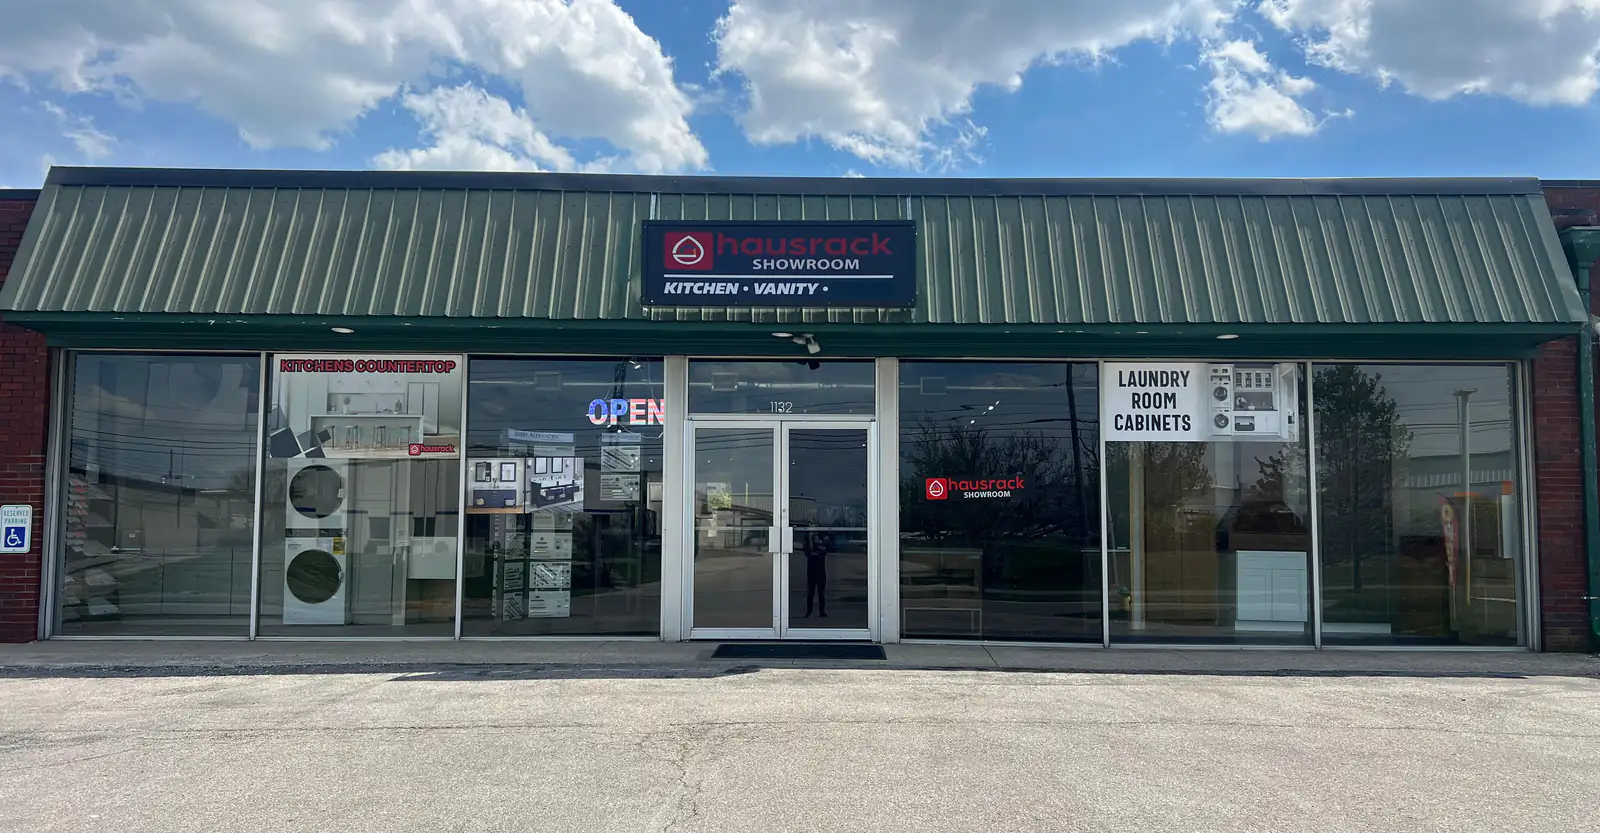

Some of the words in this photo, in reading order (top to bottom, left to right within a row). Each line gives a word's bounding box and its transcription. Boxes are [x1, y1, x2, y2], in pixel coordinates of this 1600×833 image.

[717, 232, 892, 255] hausrack
[752, 258, 860, 271] SHOWROOM
[664, 282, 739, 295] KITCHEN
[754, 282, 819, 295] VANITY
[280, 359, 354, 373] KITCHENS
[355, 360, 457, 373] COUNTERTOP
[1118, 370, 1191, 388] LAUNDRY
[770, 401, 793, 413] 1132
[1131, 392, 1177, 409] ROOM
[588, 398, 665, 425] OPEN
[1114, 413, 1192, 432] CABINETS
[948, 476, 1025, 491] hausrack
[963, 490, 1011, 499] SHOWROOM
